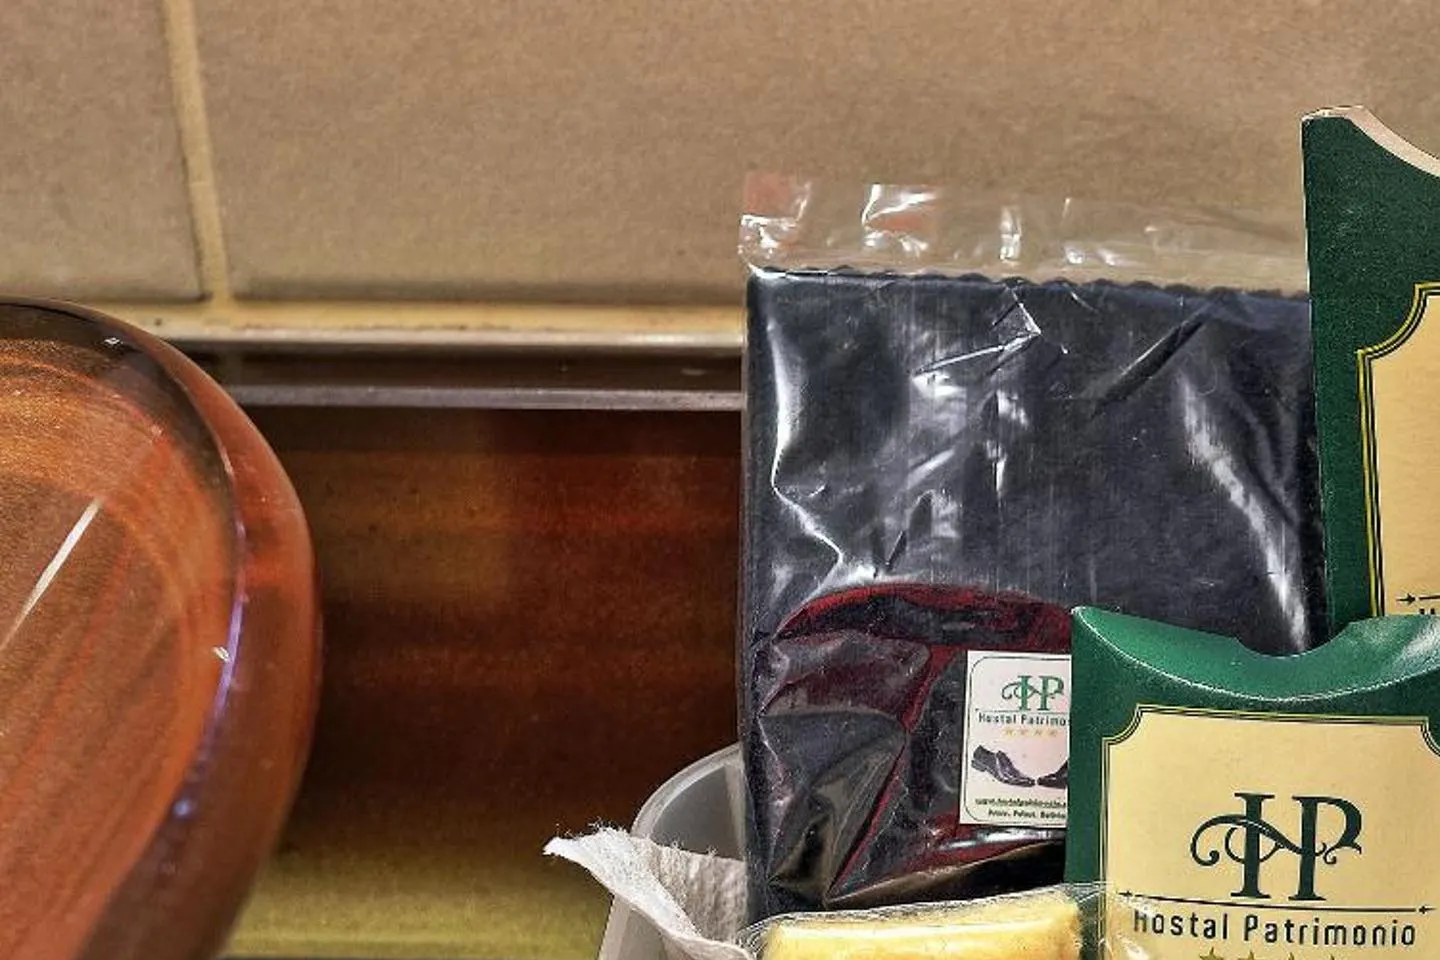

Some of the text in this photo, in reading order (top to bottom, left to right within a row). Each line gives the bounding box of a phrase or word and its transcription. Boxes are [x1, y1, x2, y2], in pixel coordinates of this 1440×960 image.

[1001, 674, 1065, 711] HP
[978, 711, 1068, 728] Hostal Patrimo
[1189, 791, 1363, 901] HP
[1133, 909, 1416, 947] Hostal Patrimonio
